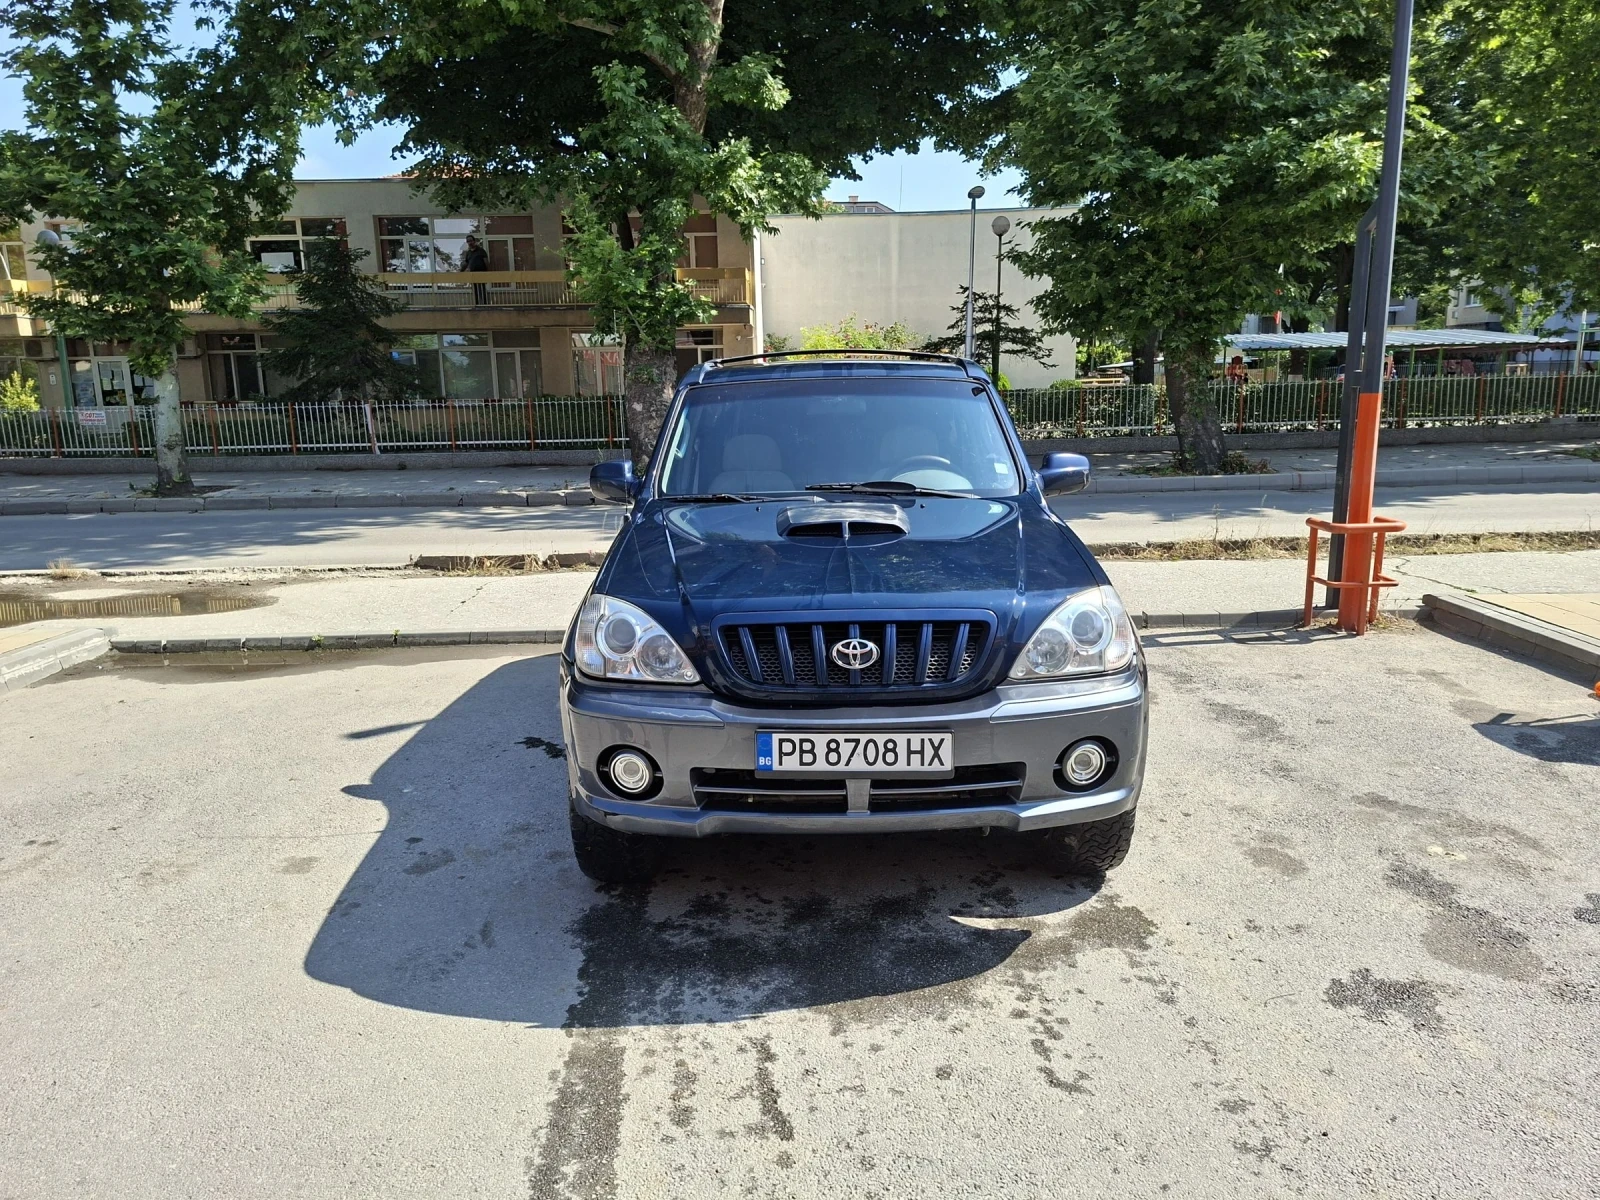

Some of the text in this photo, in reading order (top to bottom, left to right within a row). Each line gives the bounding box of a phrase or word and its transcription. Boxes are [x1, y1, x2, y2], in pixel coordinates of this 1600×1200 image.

[759, 757, 772, 765] BG
[778, 738, 945, 766] PB 8708 HX
